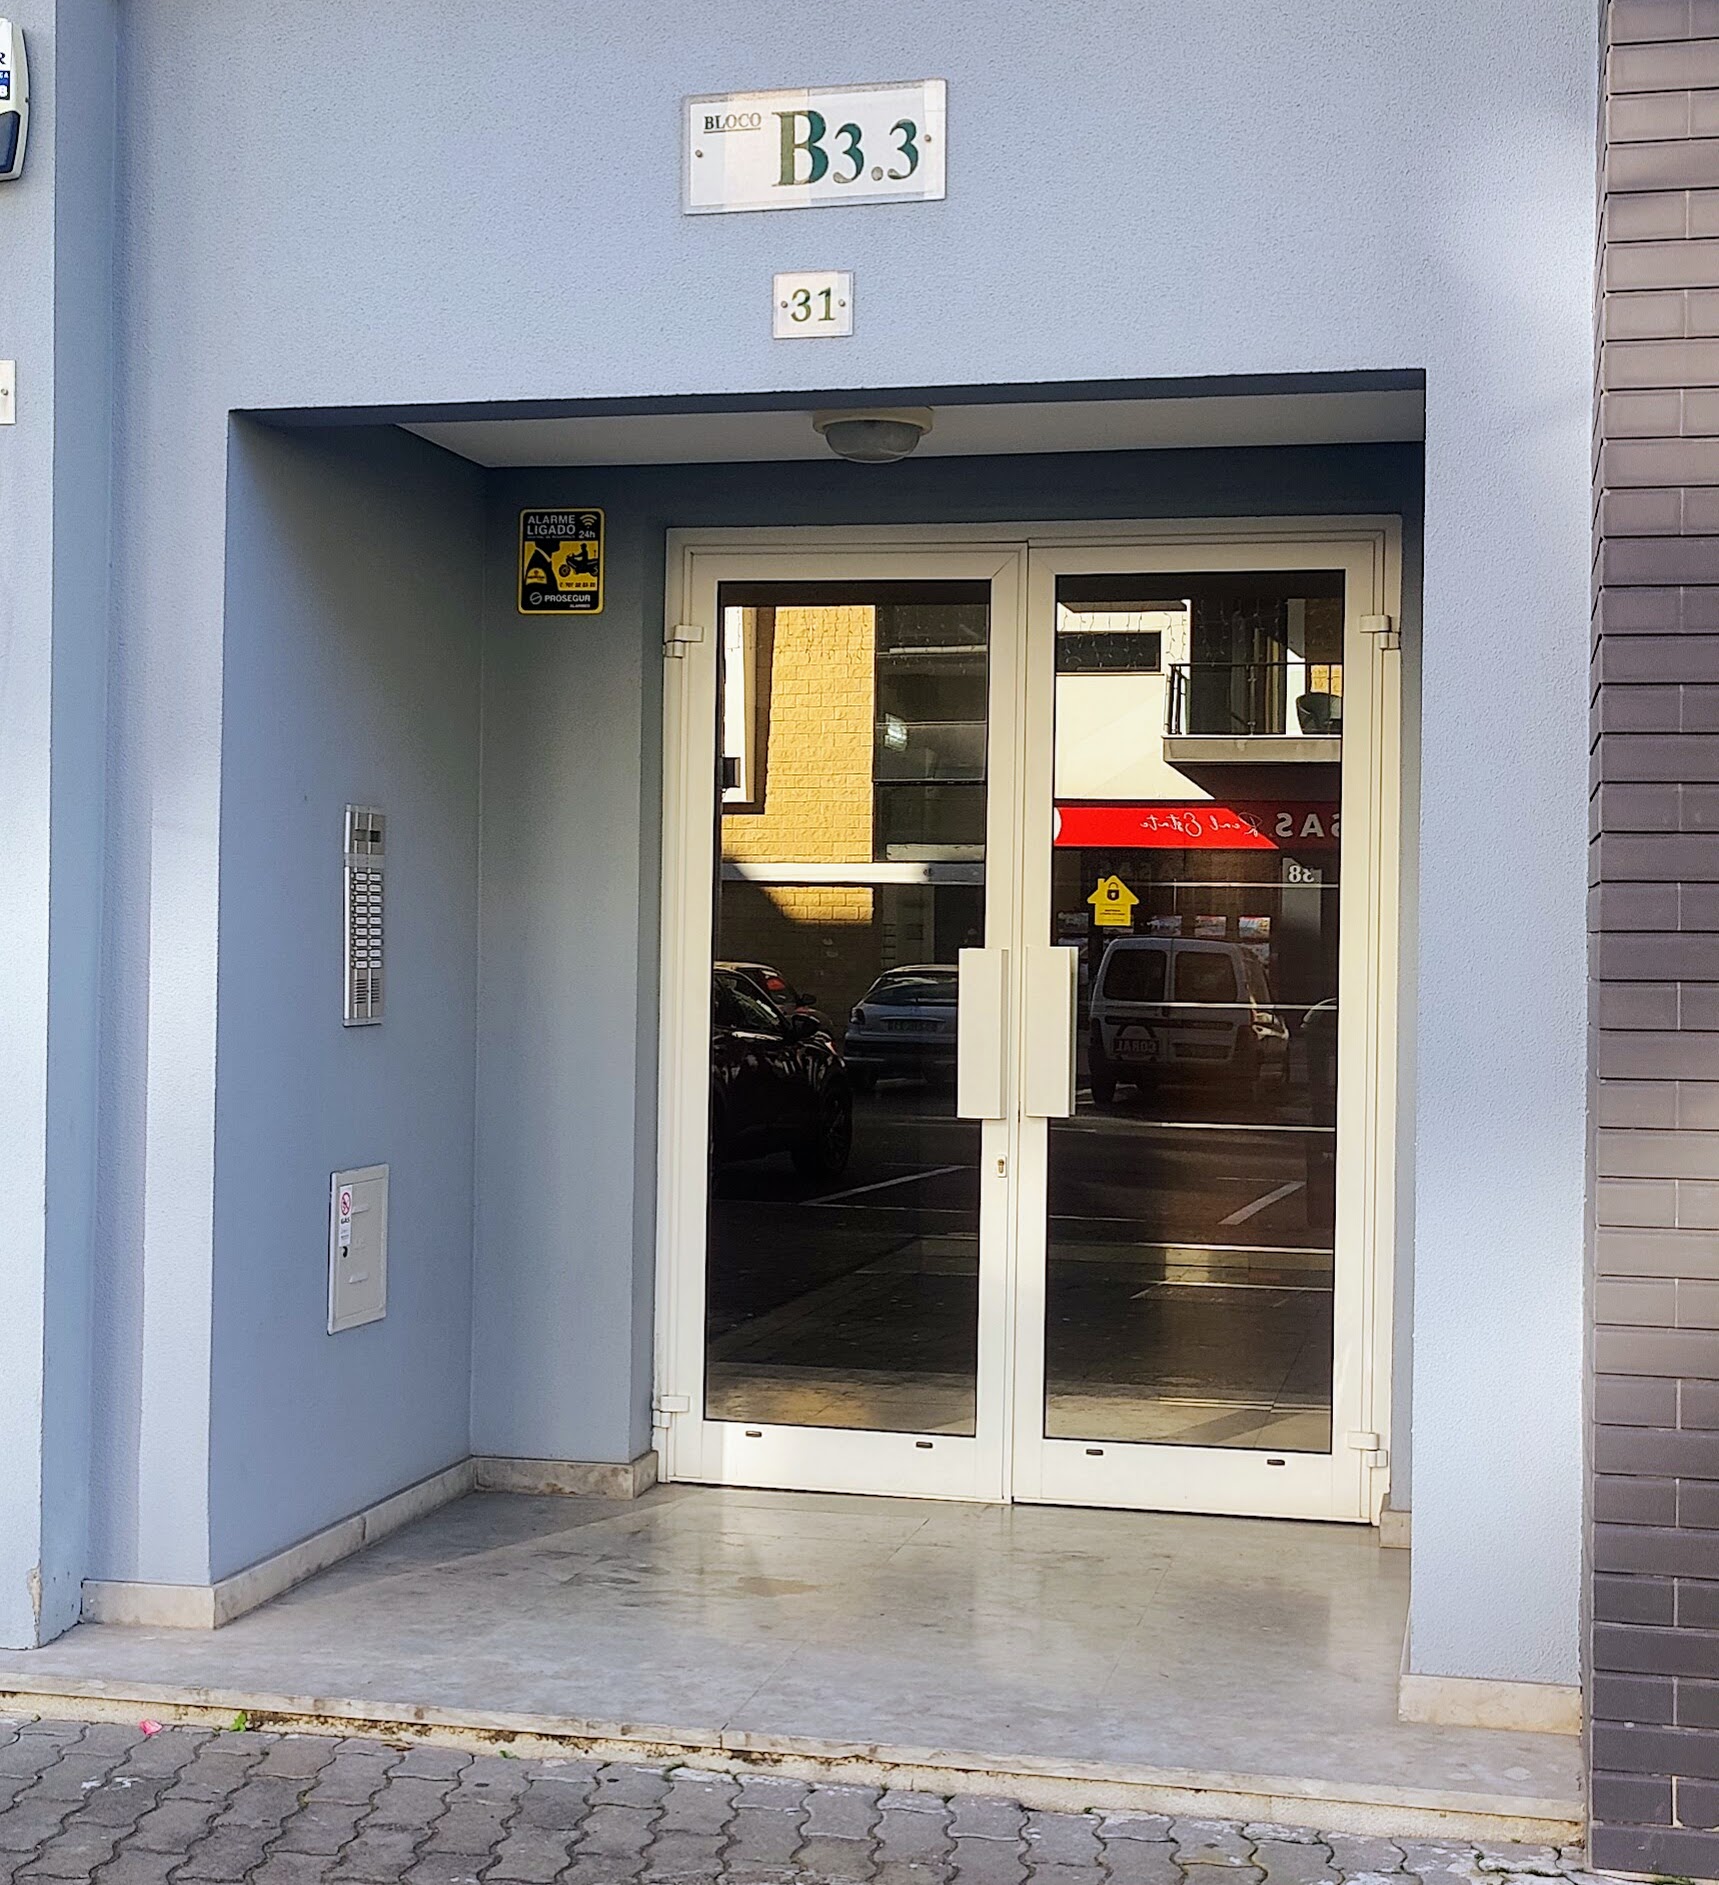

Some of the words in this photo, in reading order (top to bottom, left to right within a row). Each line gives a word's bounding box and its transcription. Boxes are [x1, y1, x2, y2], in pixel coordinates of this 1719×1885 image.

[703, 112, 762, 131] BLOCO
[771, 109, 919, 187] B3.3
[790, 286, 836, 322] 31
[528, 515, 575, 524] ALARME
[527, 524, 575, 535] LIGADO
[578, 530, 596, 539] 24h
[544, 594, 590, 602] PROSEGUR
